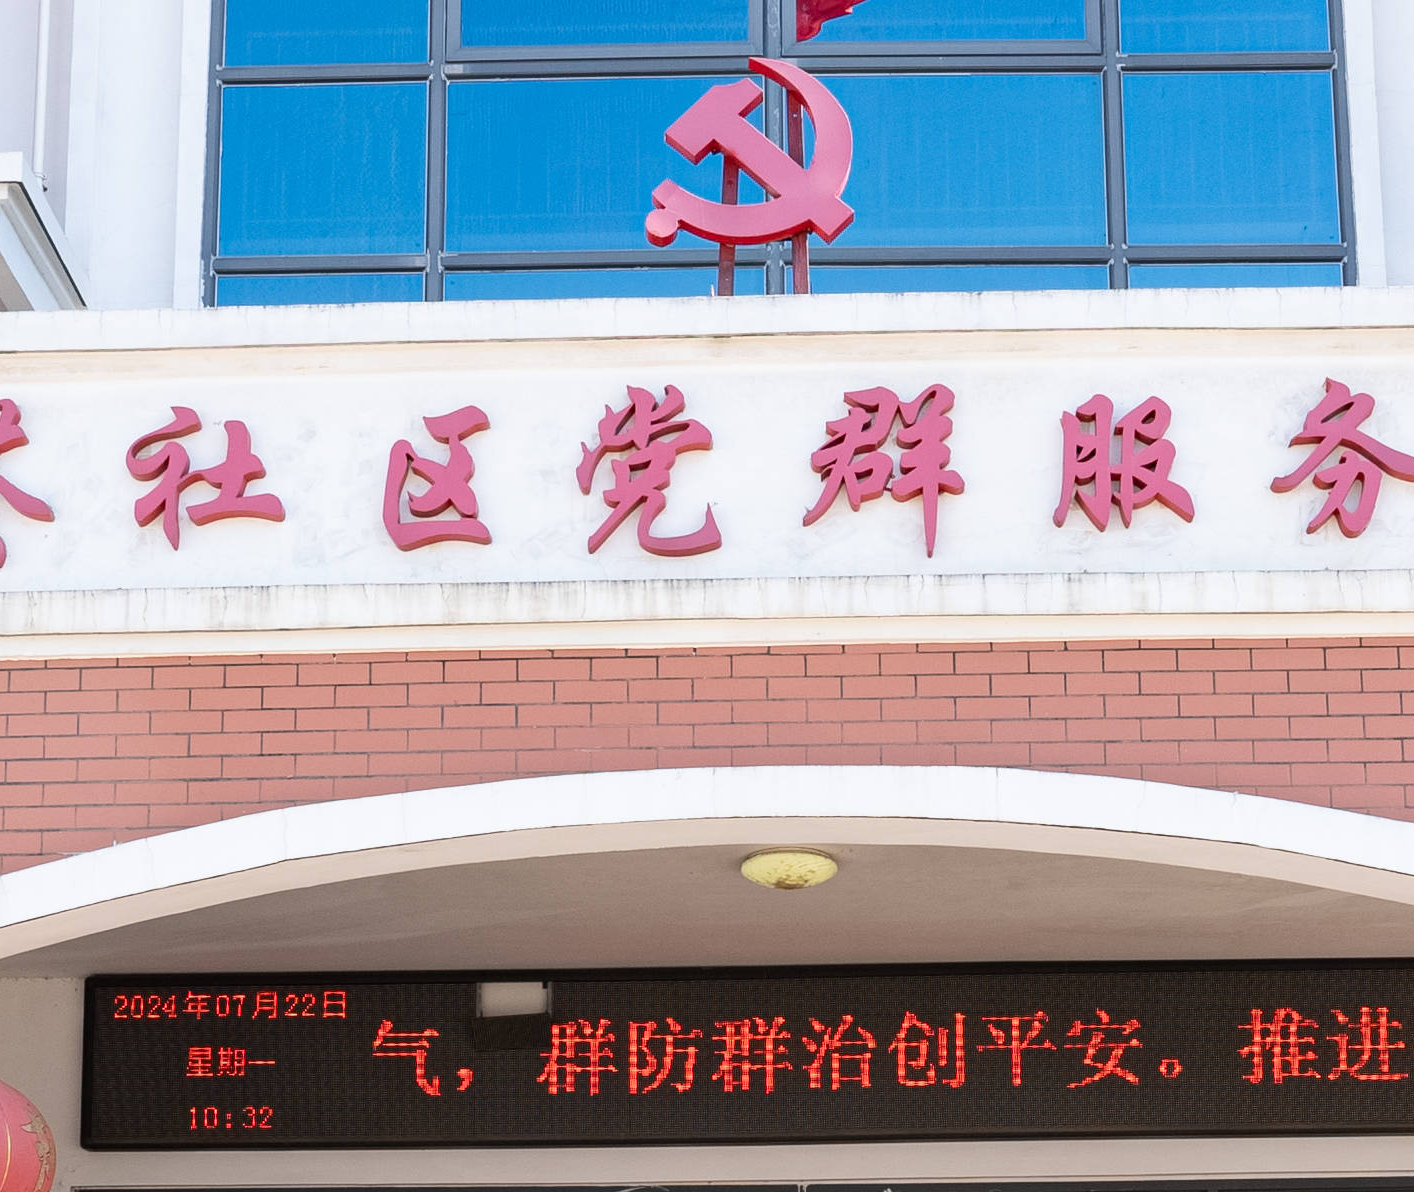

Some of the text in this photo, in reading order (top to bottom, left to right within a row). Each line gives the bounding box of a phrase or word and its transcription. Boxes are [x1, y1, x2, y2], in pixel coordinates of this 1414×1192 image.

[113, 990, 348, 1020] 2024年07月22日
[185, 1046, 276, 1078] 星期一
[188, 1106, 274, 1130] 10:32
